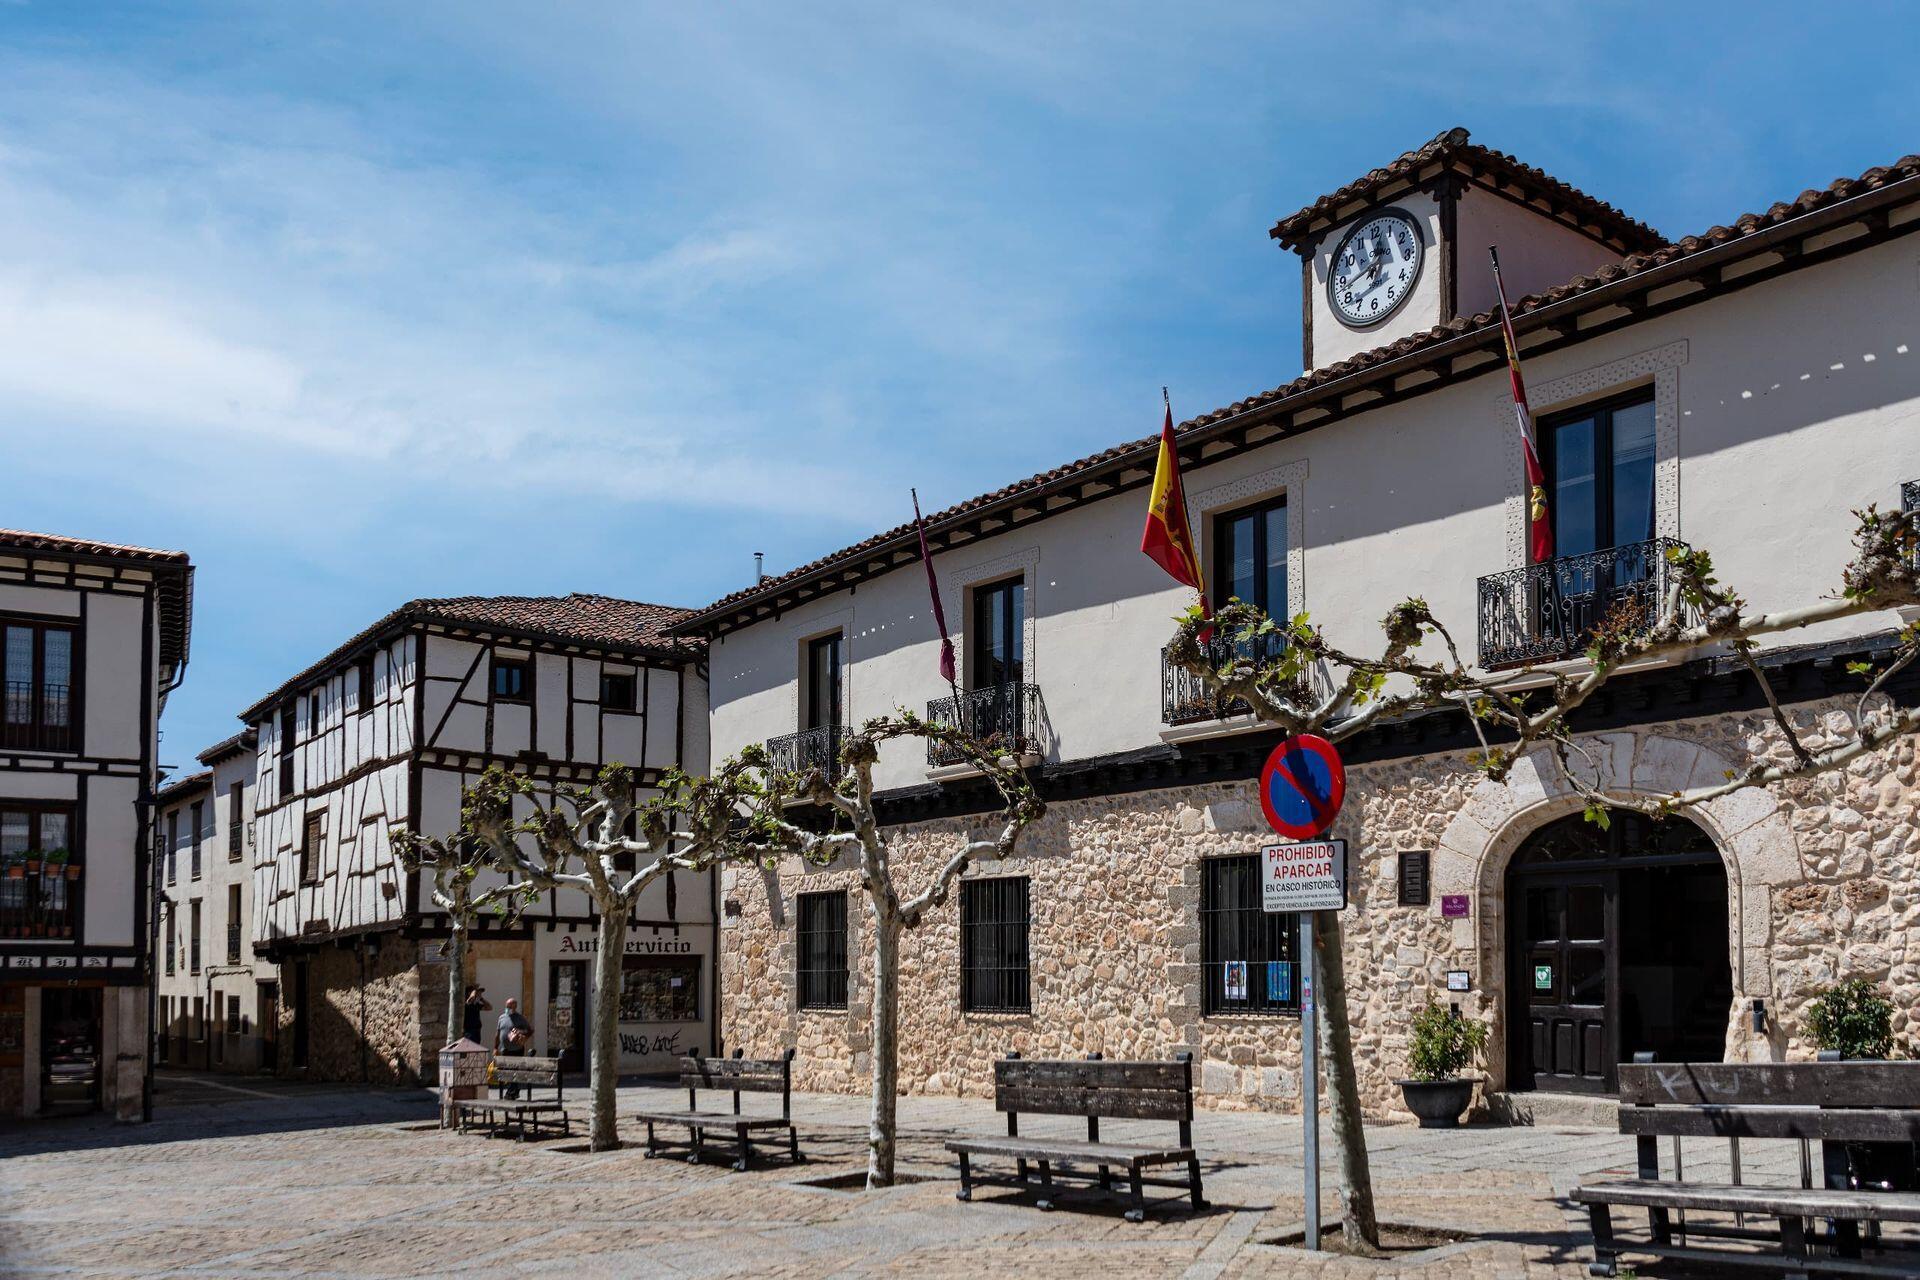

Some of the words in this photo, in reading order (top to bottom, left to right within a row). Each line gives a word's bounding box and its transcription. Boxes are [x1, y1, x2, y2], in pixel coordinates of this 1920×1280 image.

[1371, 225, 1380, 240] 12
[1388, 225, 1392, 237] 1
[1357, 237, 1364, 250] 11
[1398, 232, 1406, 245] 2
[1344, 254, 1355, 268] 10
[1404, 249, 1411, 262] 3
[1399, 268, 1406, 281] 4
[1339, 276, 1347, 288] 9
[1344, 291, 1353, 304] 8
[1387, 285, 1395, 299] 5
[1355, 298, 1364, 311] 7
[1370, 298, 1378, 310] 6
[1269, 845, 1336, 862] PROHIBIDO
[1273, 862, 1332, 880] APARCAR
[1265, 884, 1275, 893] EN
[1276, 882, 1301, 892] CASCO
[560, 936, 691, 953] Autervicio
